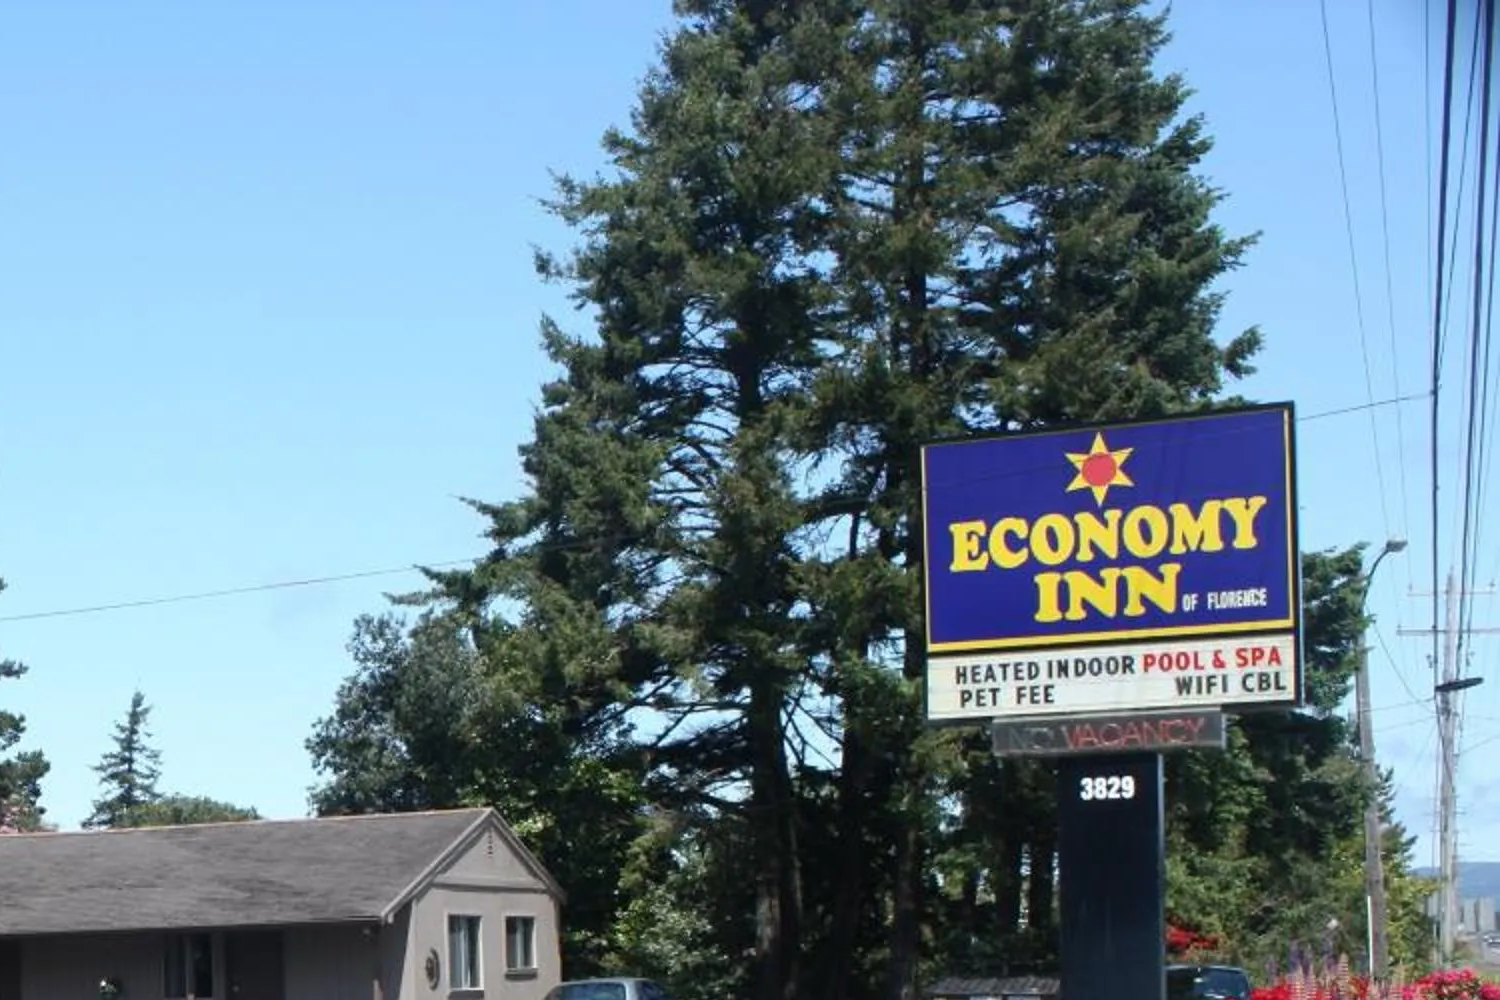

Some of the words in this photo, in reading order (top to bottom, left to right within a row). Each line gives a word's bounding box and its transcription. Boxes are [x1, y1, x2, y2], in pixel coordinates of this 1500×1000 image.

[949, 495, 1267, 572] ECONOMY
[1033, 563, 1181, 623] INN
[1182, 593, 1199, 612] OF
[1207, 587, 1267, 610] FLORENCE
[955, 661, 1040, 685] HEATED
[1047, 655, 1135, 679] INDOOR
[1143, 651, 1205, 673] POOL
[1212, 649, 1227, 669] &
[1235, 645, 1282, 668] SPA
[960, 687, 1000, 708] PET
[1016, 685, 1055, 704] FEE
[1174, 673, 1229, 696] WIFI
[1241, 671, 1287, 692] CBL
[1061, 717, 1205, 750] VACANCY
[1080, 776, 1136, 801] 3829
